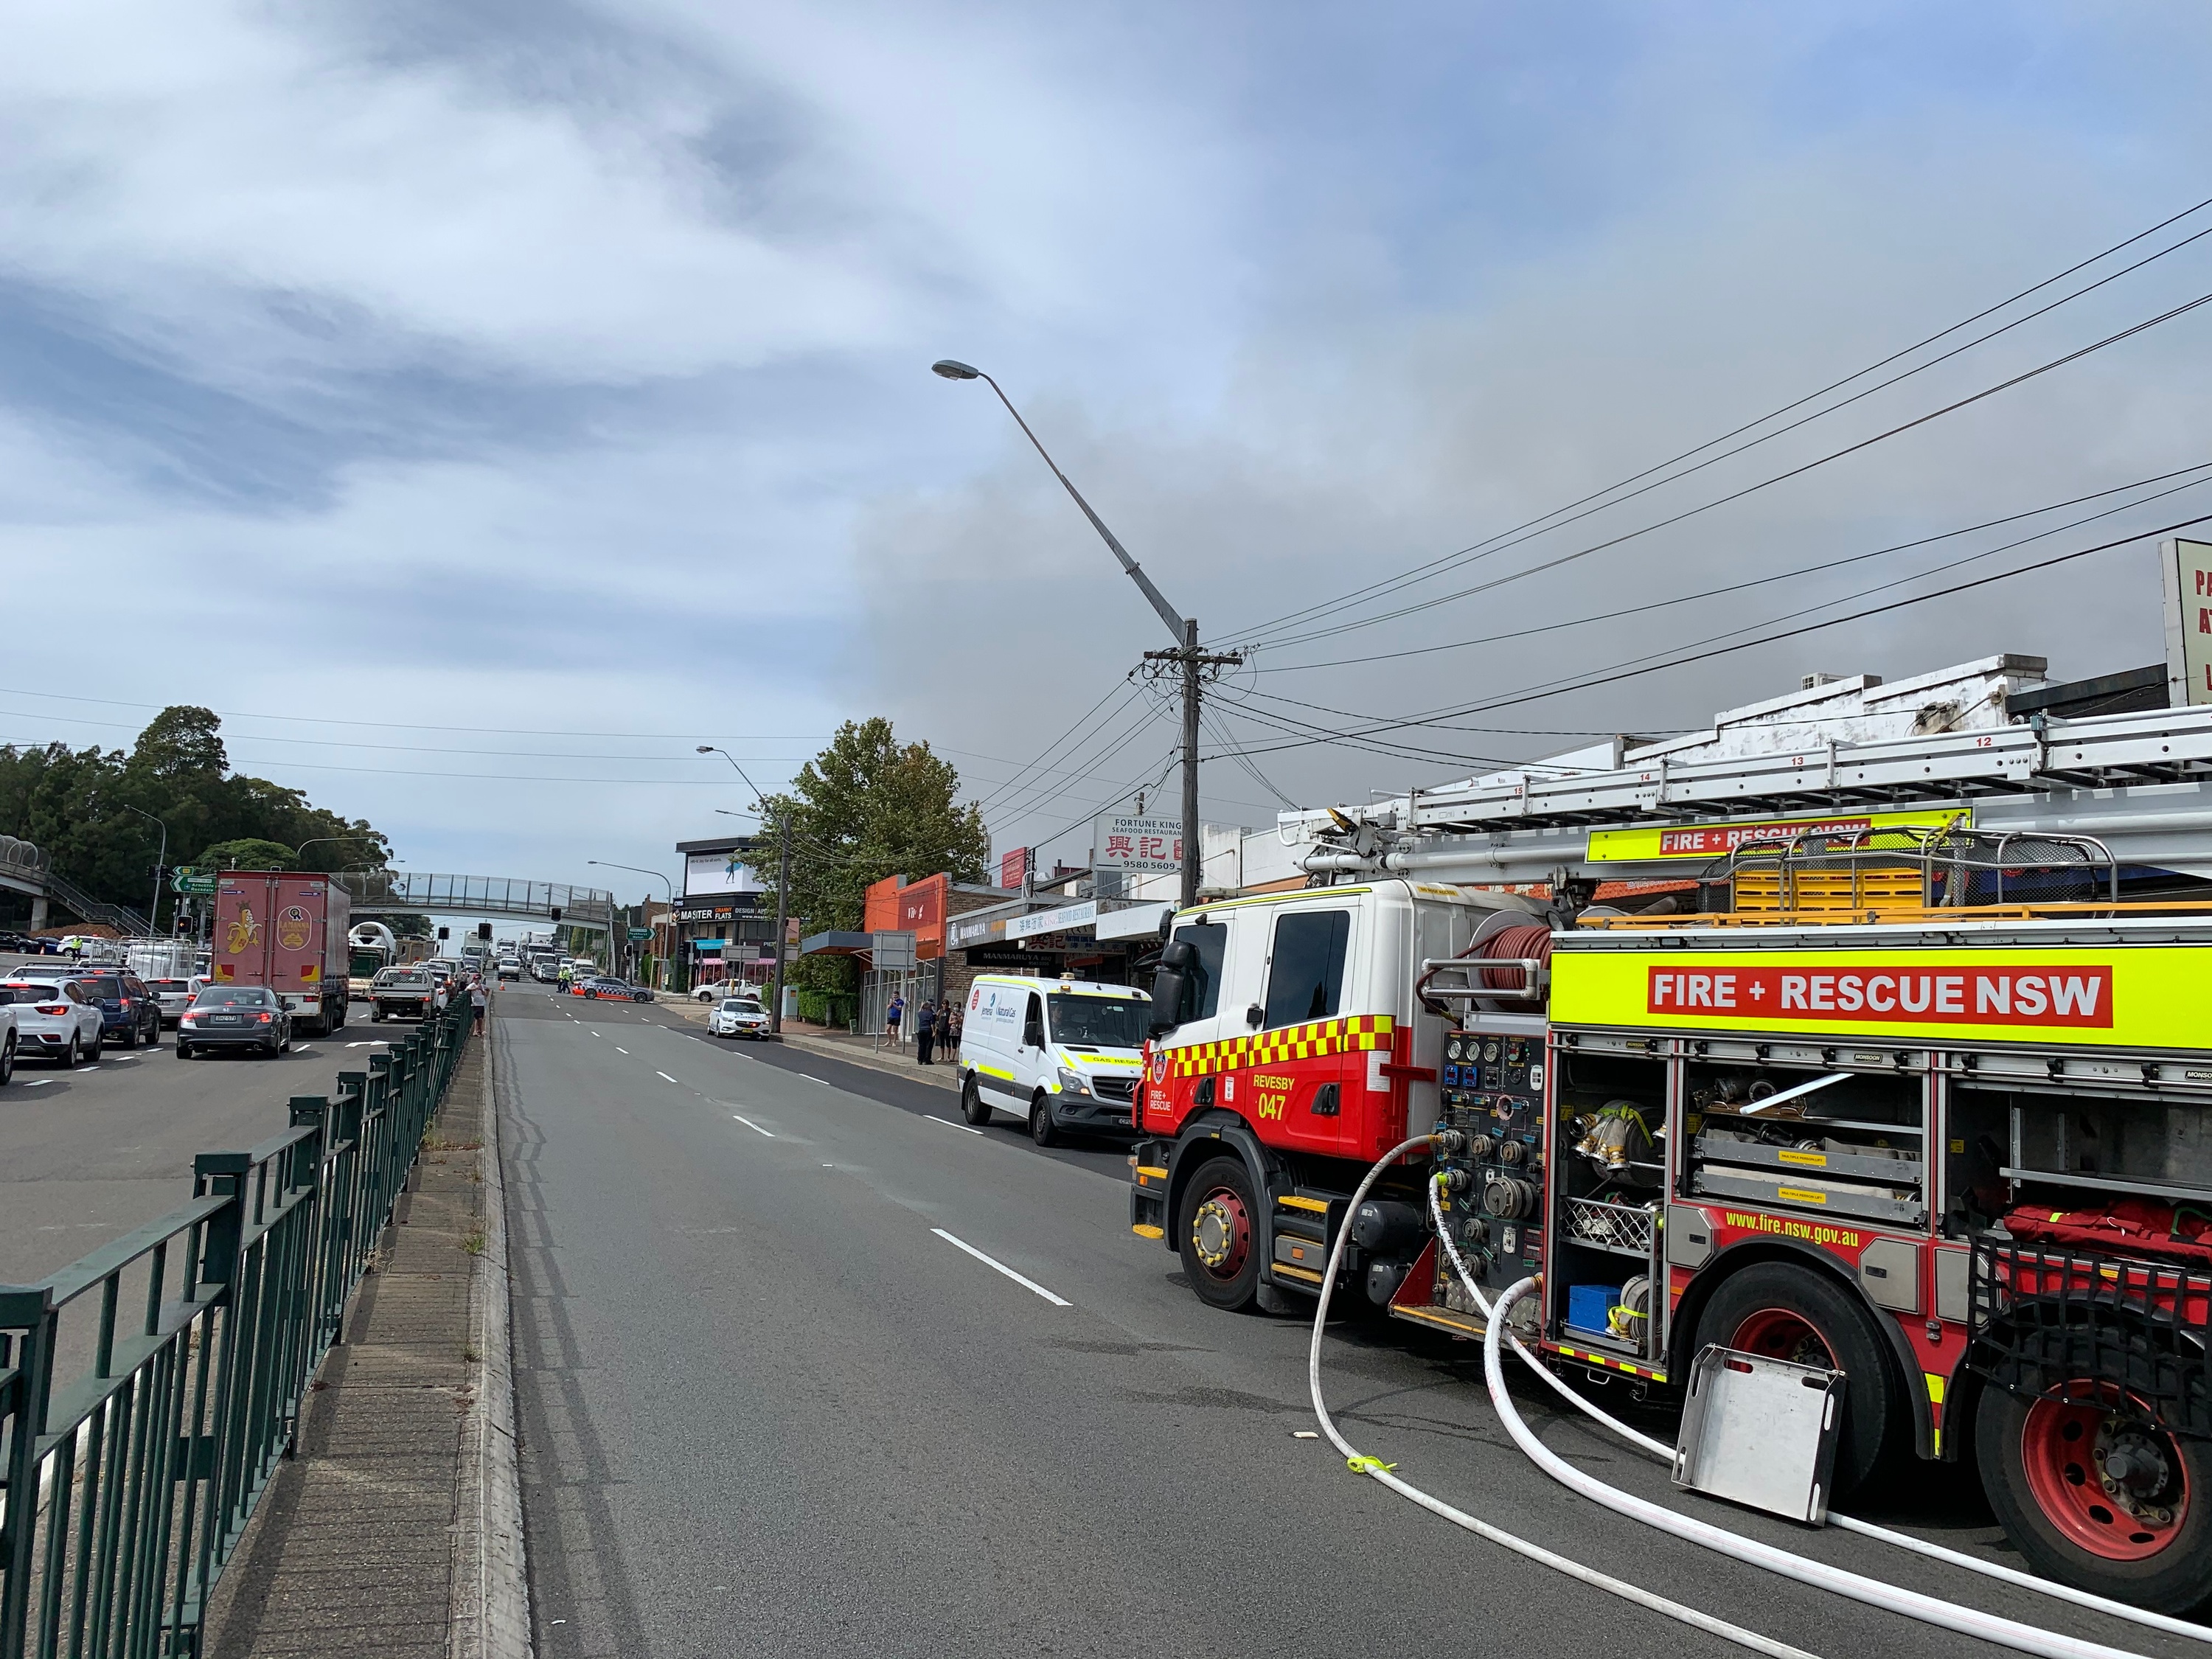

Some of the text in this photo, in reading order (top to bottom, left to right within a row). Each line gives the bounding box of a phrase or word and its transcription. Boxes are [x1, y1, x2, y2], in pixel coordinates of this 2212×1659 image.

[1976, 737, 1992, 747] 12
[1792, 756, 1804, 765] 13
[1640, 773, 1651, 782] 14
[1115, 818, 1181, 830] FORTUNE KING
[1662, 832, 1705, 851] FIRE
[1124, 860, 1175, 870] 9580 5609
[681, 909, 712, 920] MASTER
[1072, 905, 1094, 922] RESTAURANT
[959, 922, 986, 940] MANMARUYA
[983, 952, 1039, 961] MANMARUYA
[1654, 973, 1736, 1007] FIRE
[1781, 975, 1964, 1013] RESCUE
[1976, 975, 2101, 1016] NSW
[1253, 1074, 1295, 1091] REVESBY
[1150, 1100, 1171, 1111] RESCUE
[1258, 1093, 1286, 1121] 047
[1726, 1211, 1859, 1248] www.fire.nsw.gov.au
